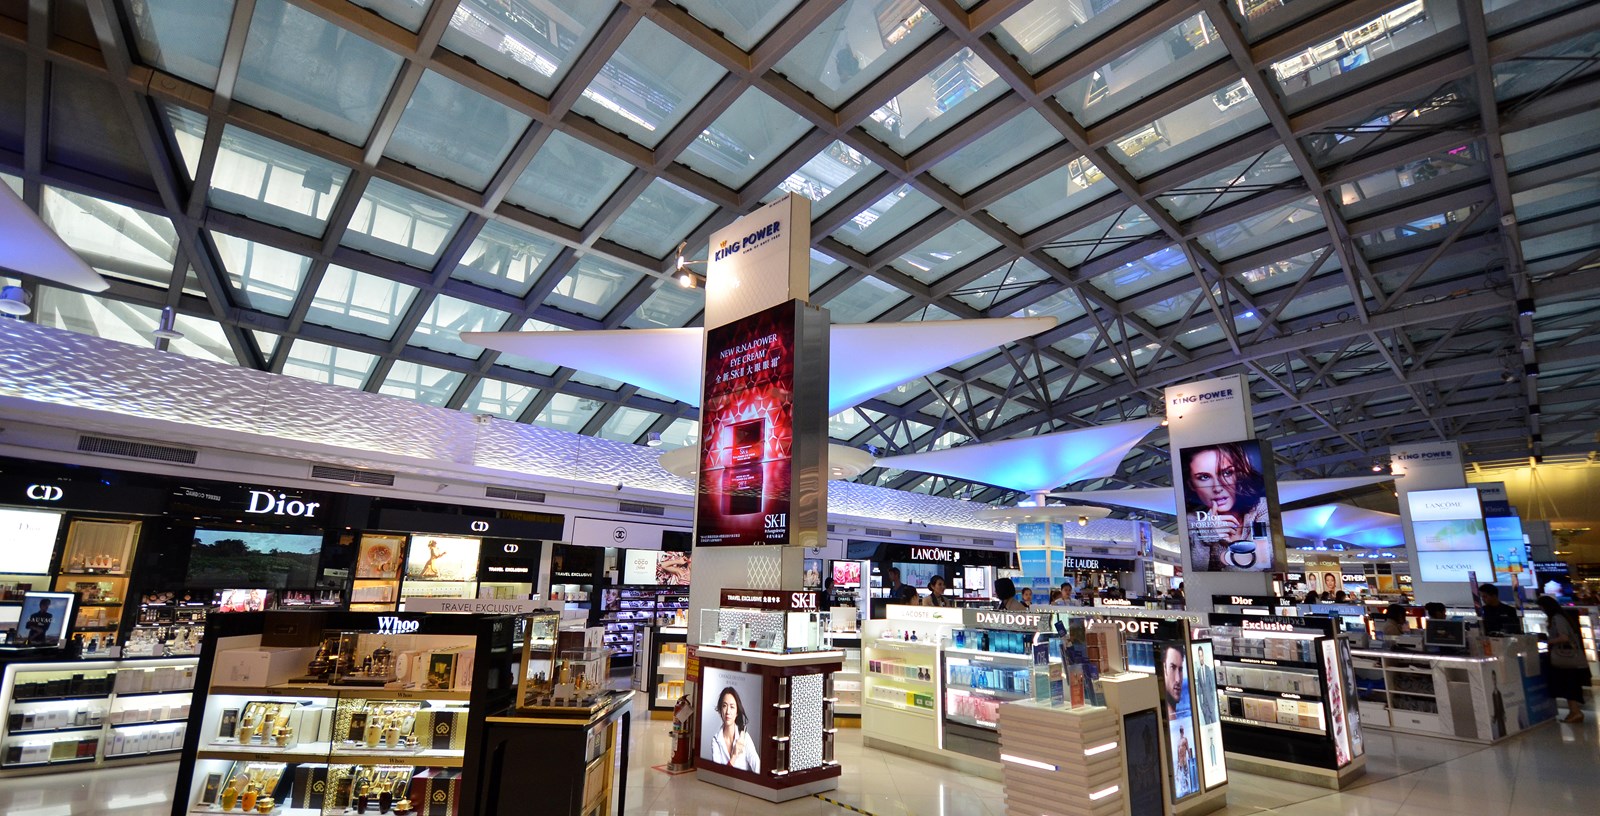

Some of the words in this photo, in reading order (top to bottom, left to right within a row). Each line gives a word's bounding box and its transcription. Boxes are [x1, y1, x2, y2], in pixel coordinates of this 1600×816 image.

[714, 241, 741, 262] KING
[742, 221, 780, 249] POWER
[719, 347, 735, 360] NEW
[729, 356, 741, 368] EYE
[742, 349, 765, 364] CREAM
[1172, 395, 1197, 405] KING
[1199, 388, 1233, 401] POWER
[1397, 452, 1419, 461] KING
[1421, 450, 1452, 458] POWER
[245, 490, 320, 518] Dior
[764, 513, 786, 528] SK-II
[1195, 510, 1221, 522] Dior
[911, 547, 953, 562] LANCÔME
[1075, 559, 1099, 569] LAUDER
[791, 593, 817, 608] SK-II
[1230, 595, 1253, 605] Dior
[1280, 597, 1291, 606] Dior
[441, 602, 472, 612] TRAVEL
[475, 603, 523, 613] EXCLUSIVE
[902, 610, 929, 619] LACOSTE
[377, 616, 420, 631] Whoo
[976, 612, 1041, 627] DAVIDOFF
[1242, 619, 1294, 632] Exclusive
